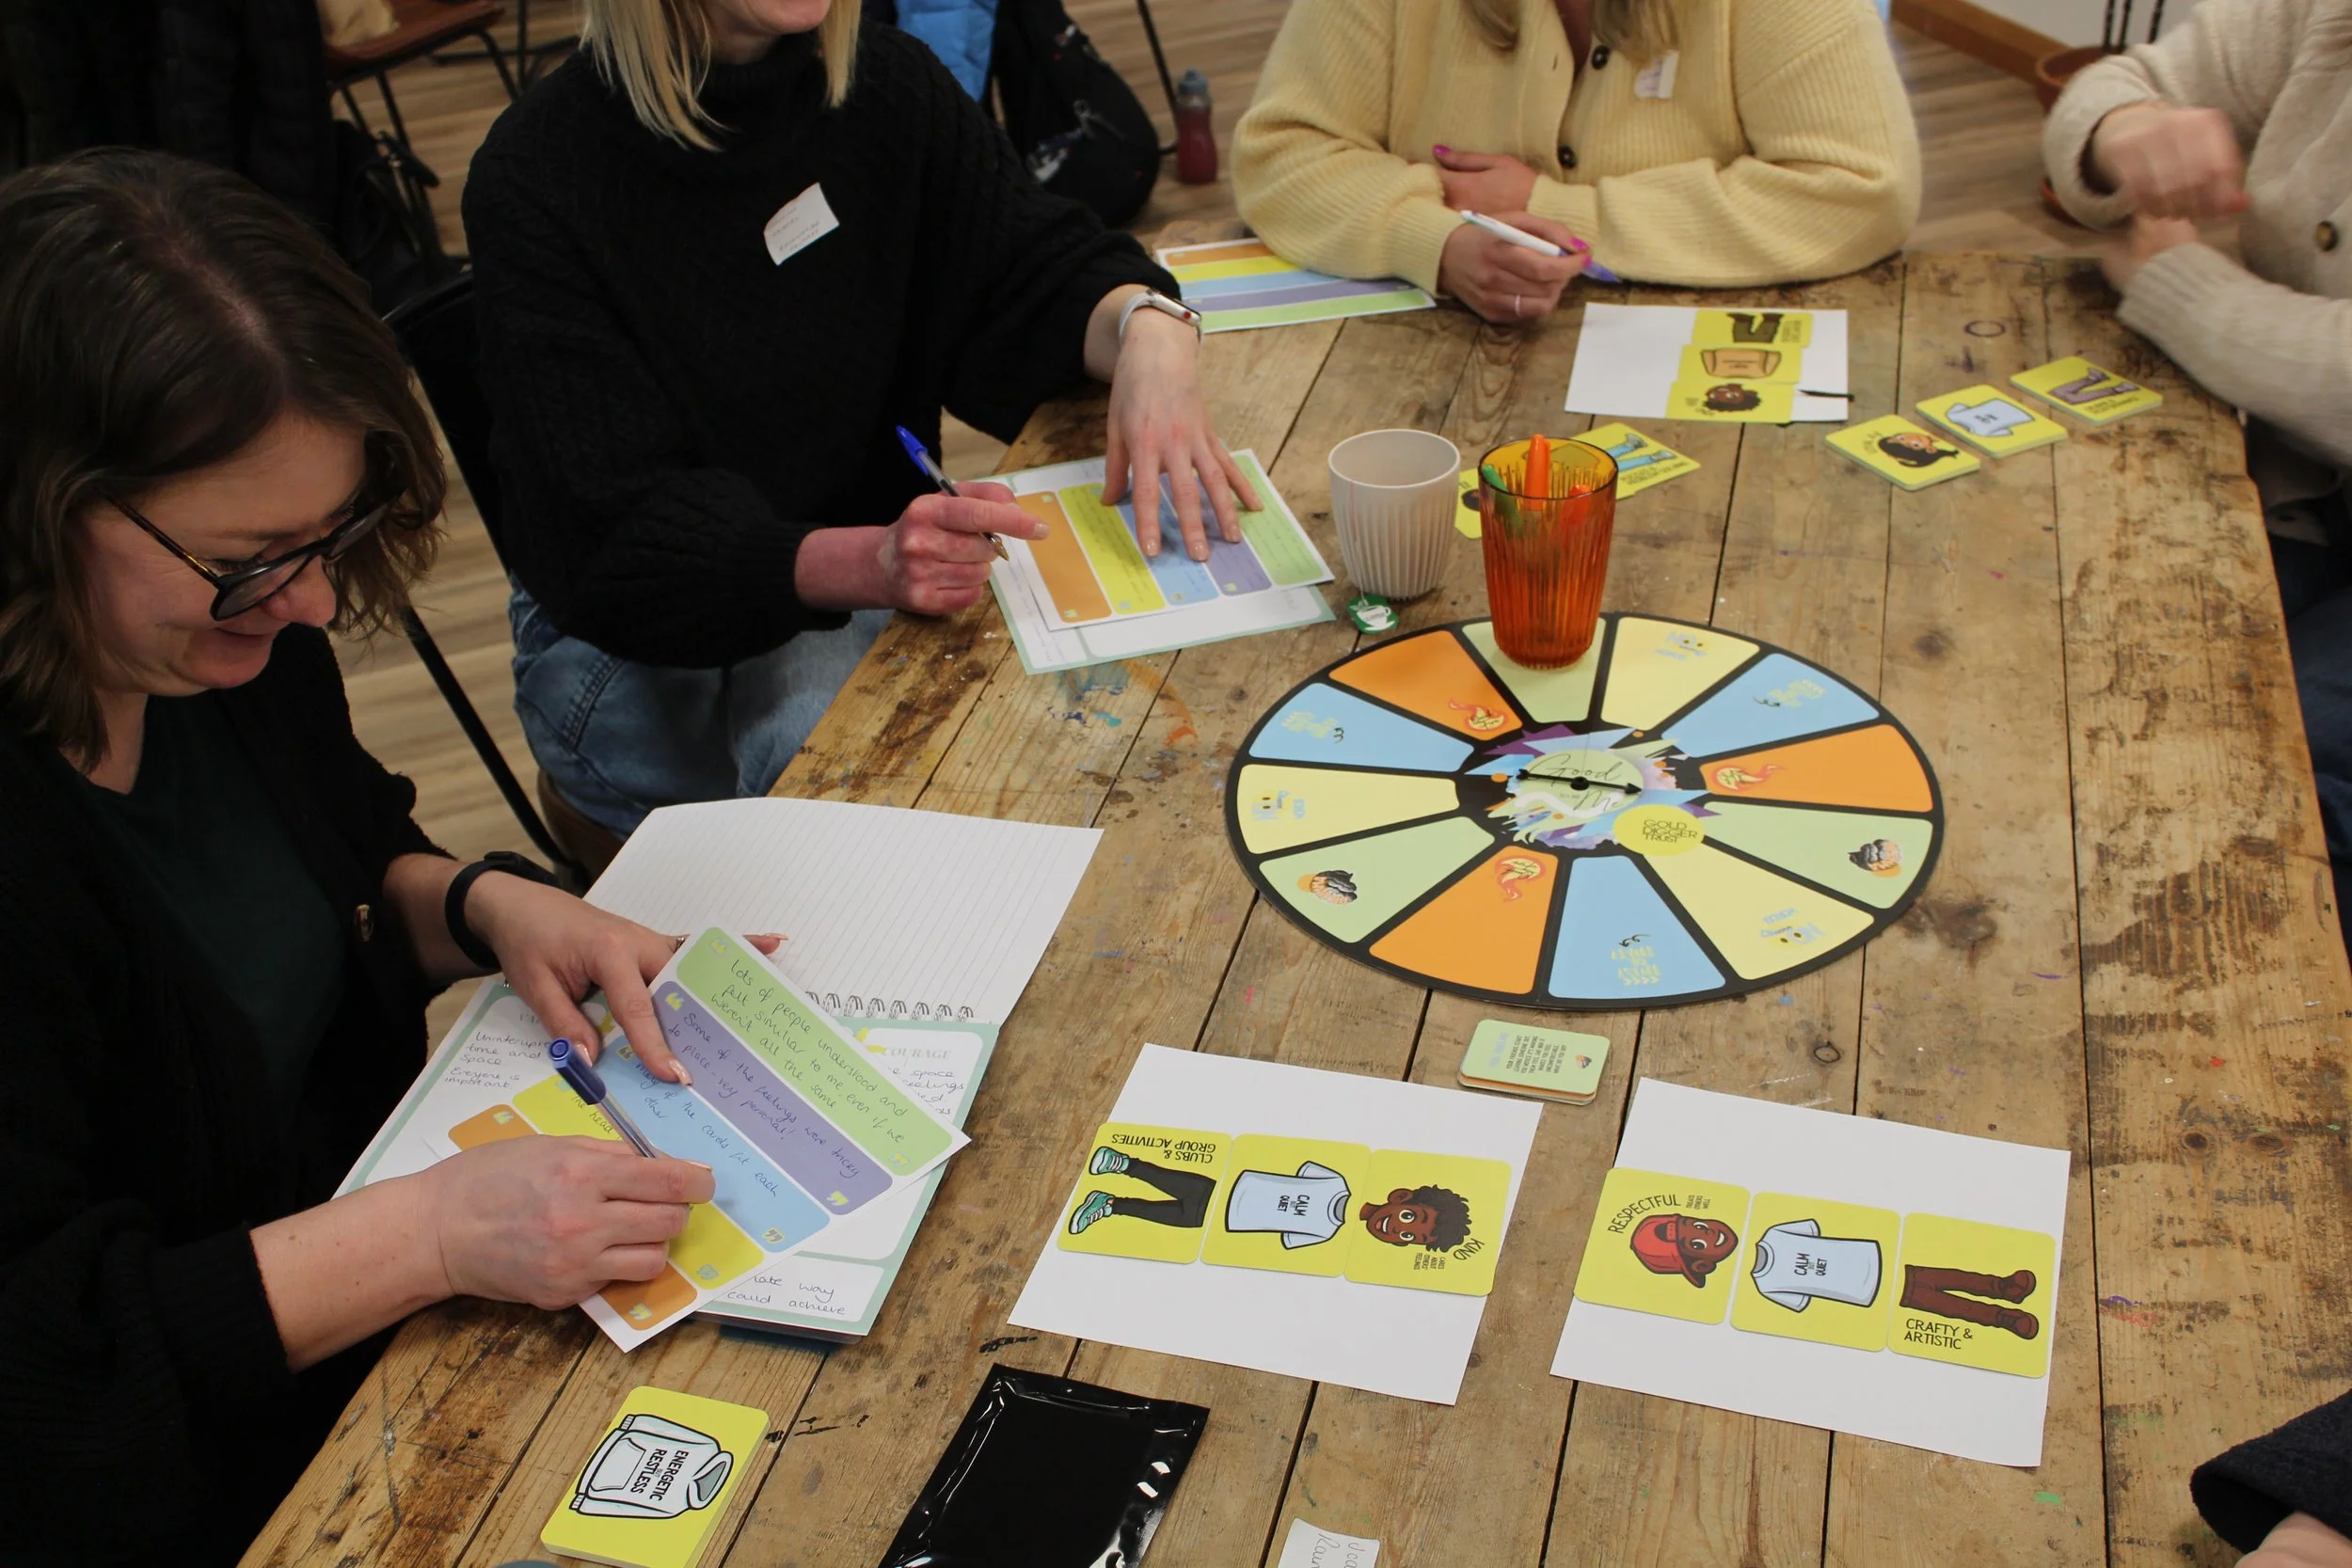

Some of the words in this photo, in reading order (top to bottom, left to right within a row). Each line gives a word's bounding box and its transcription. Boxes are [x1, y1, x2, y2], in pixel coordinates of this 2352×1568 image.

[1642, 827, 1698, 839] DIGGER
[1644, 819, 1688, 830] GOLD
[1645, 833, 1678, 843] TRUST
[466, 1043, 500, 1054] time
[758, 988, 774, 1004] of
[771, 1003, 811, 1034] people
[818, 1038, 879, 1092] understood
[879, 1096, 909, 1117] and
[668, 1022, 681, 1037] to
[681, 1045, 711, 1069] place
[718, 1077, 739, 1099] very
[722, 984, 749, 1006] felt
[809, 1058, 821, 1072] to
[846, 1093, 870, 1114] even
[872, 1116, 888, 1129] if
[886, 1129, 906, 1143] we
[759, 1037, 780, 1055] all
[784, 1059, 803, 1081] the
[811, 1085, 836, 1108] same
[683, 1013, 711, 1043] Some
[717, 1046, 731, 1060] of
[736, 1062, 755, 1083] the
[755, 1085, 798, 1124] feelings
[804, 1127, 827, 1145] were
[831, 1147, 860, 1179] tricky
[644, 1097, 670, 1119] other
[682, 1101, 696, 1119] the
[701, 1124, 730, 1148] cards
[728, 1151, 752, 1165] fit
[754, 1171, 780, 1197] each
[1111, 1133, 1172, 1148] ACTIVITIES
[1174, 1140, 1216, 1153] GROUP
[1163, 1149, 1172, 1160] &
[1174, 1150, 1214, 1164] CLUBS
[1277, 1195, 1290, 1212] QUIET
[1293, 1195, 1311, 1216] CALM
[1607, 1194, 1681, 1234] RESPECTFUL
[1453, 1238, 1486, 1260] KIND
[1794, 1252, 1811, 1276] CALM
[1815, 1258, 1828, 1276] QUIET
[727, 1290, 771, 1305] could
[788, 1299, 846, 1316] achieve
[799, 1283, 835, 1303] way
[1903, 1330, 1962, 1350] ARTISTIC
[1905, 1318, 1961, 1337] CRAFTY
[1963, 1327, 1973, 1340] &
[630, 1448, 668, 1494] RESTLESS
[649, 1449, 690, 1501] ENERGETIC
